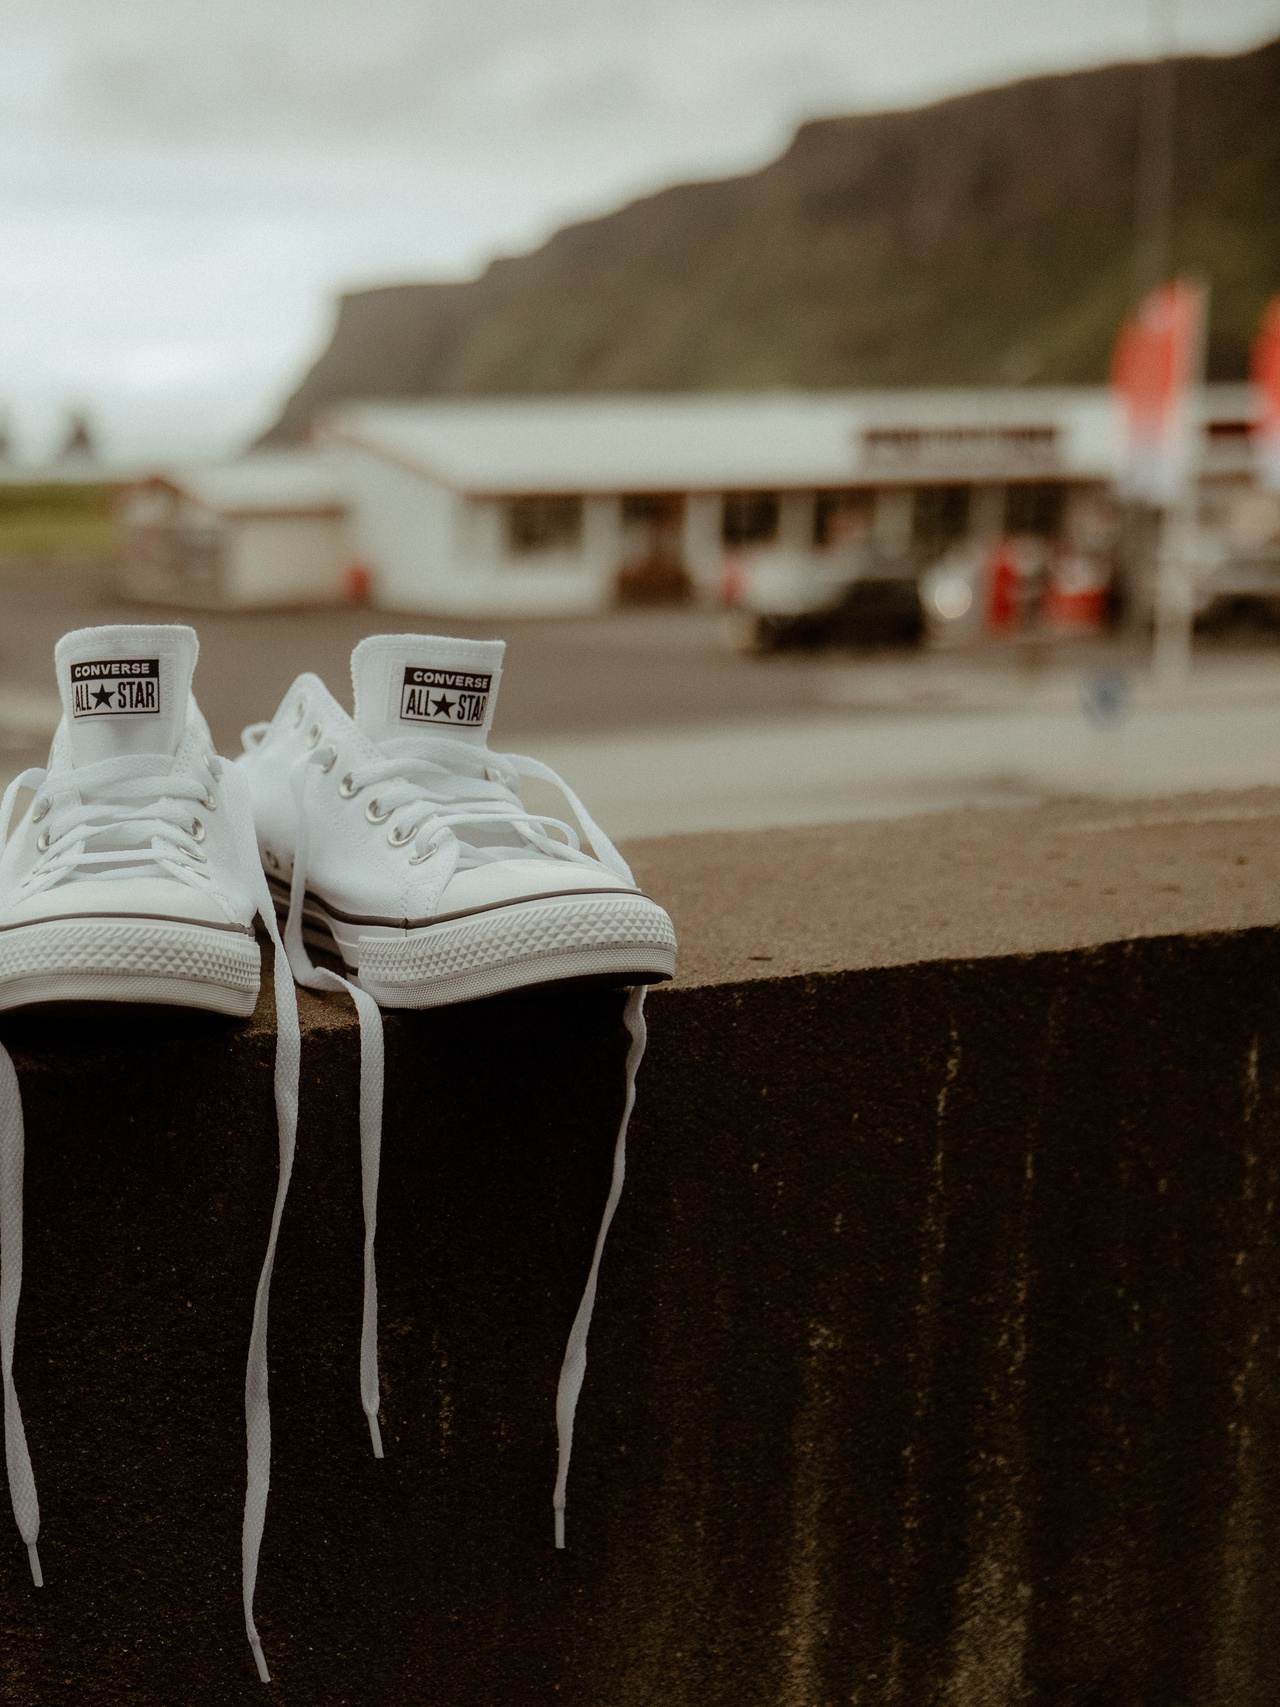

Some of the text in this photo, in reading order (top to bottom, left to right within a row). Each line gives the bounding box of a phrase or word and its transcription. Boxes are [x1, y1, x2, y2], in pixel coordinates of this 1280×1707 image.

[74, 662, 150, 678] CONVERSE
[413, 671, 489, 689] CONVERSE
[75, 681, 155, 712] ALL STAR
[406, 688, 431, 717] ALL
